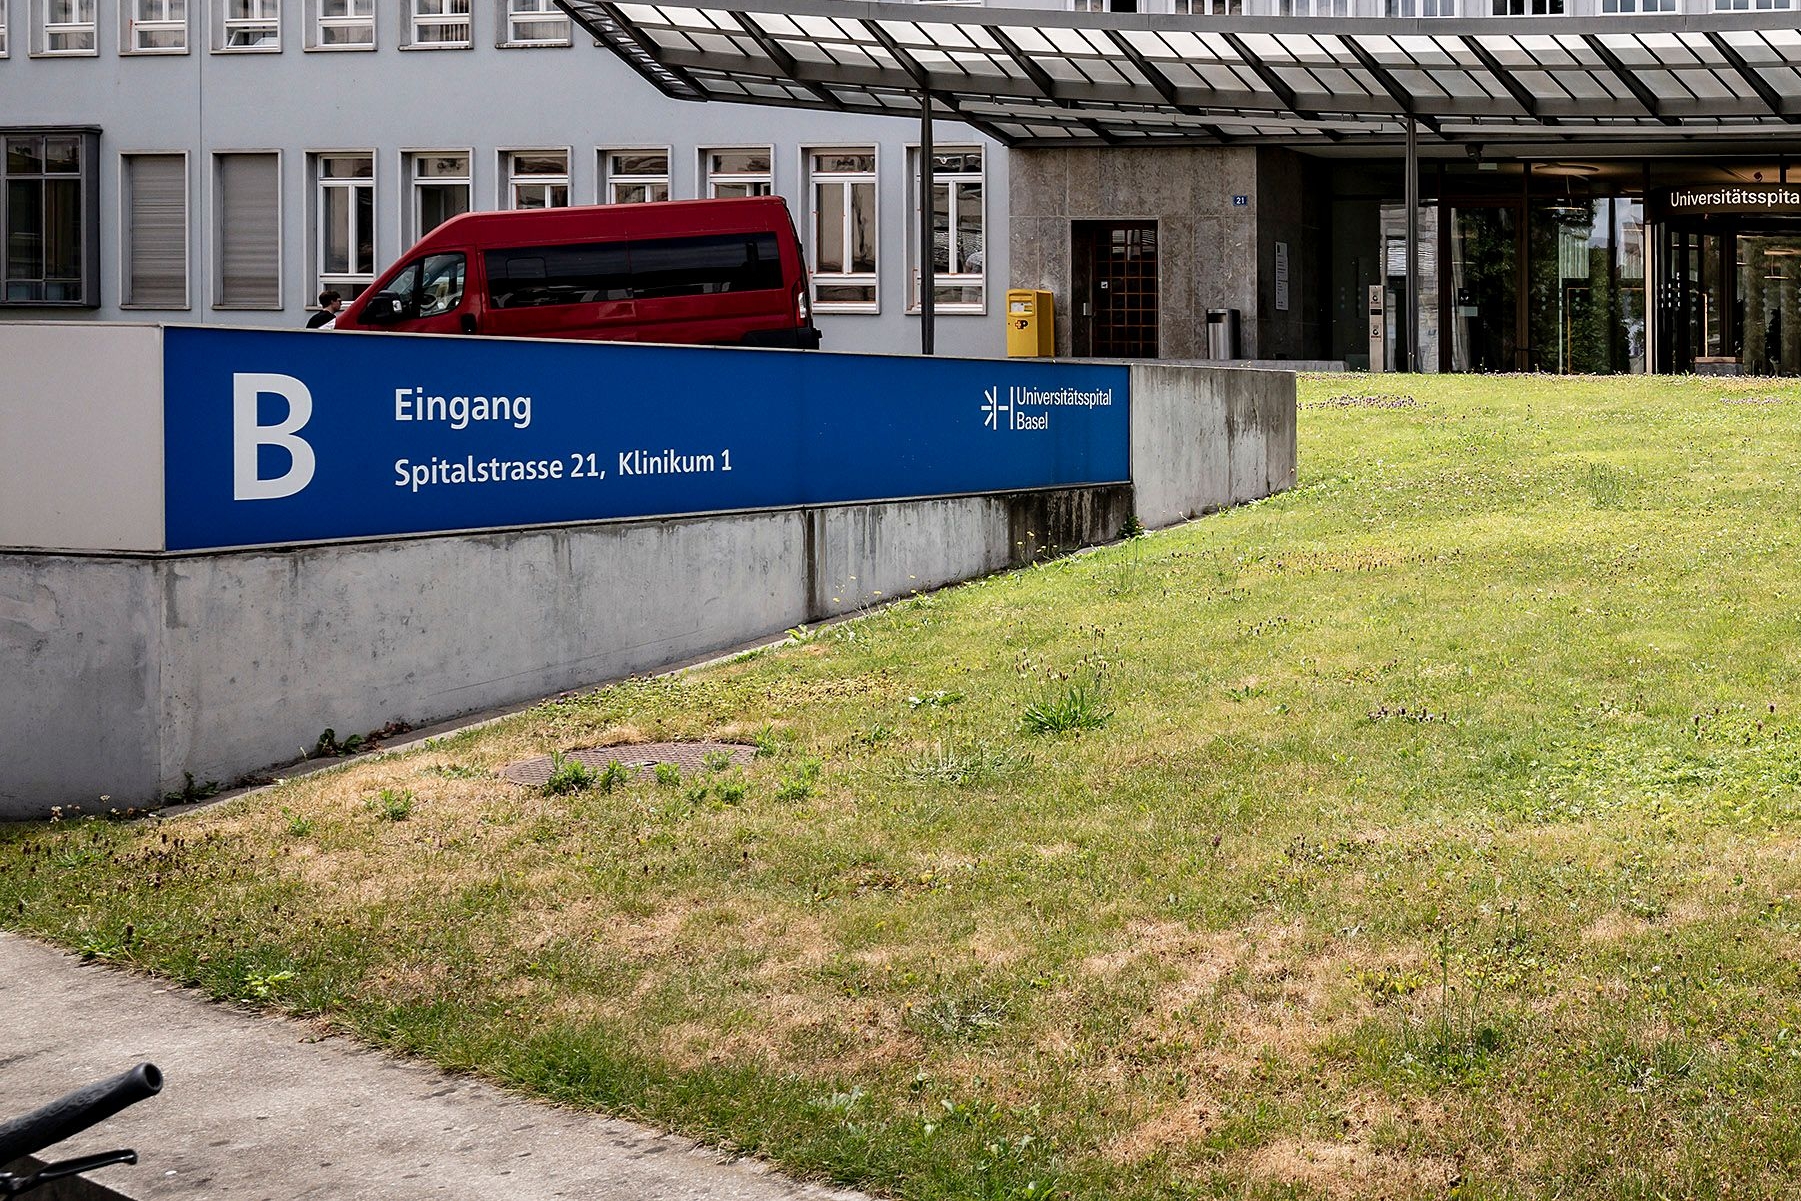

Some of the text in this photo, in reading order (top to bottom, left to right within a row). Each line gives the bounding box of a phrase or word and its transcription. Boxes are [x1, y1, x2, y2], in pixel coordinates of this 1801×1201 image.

[1236, 196, 1245, 205] 21
[394, 387, 532, 429] Eingang
[1016, 386, 1112, 410] Universitätsspital
[233, 372, 316, 501] B
[1016, 411, 1048, 430] Basel
[394, 448, 732, 493] Spitalstrasse 21, Klinikum 1
